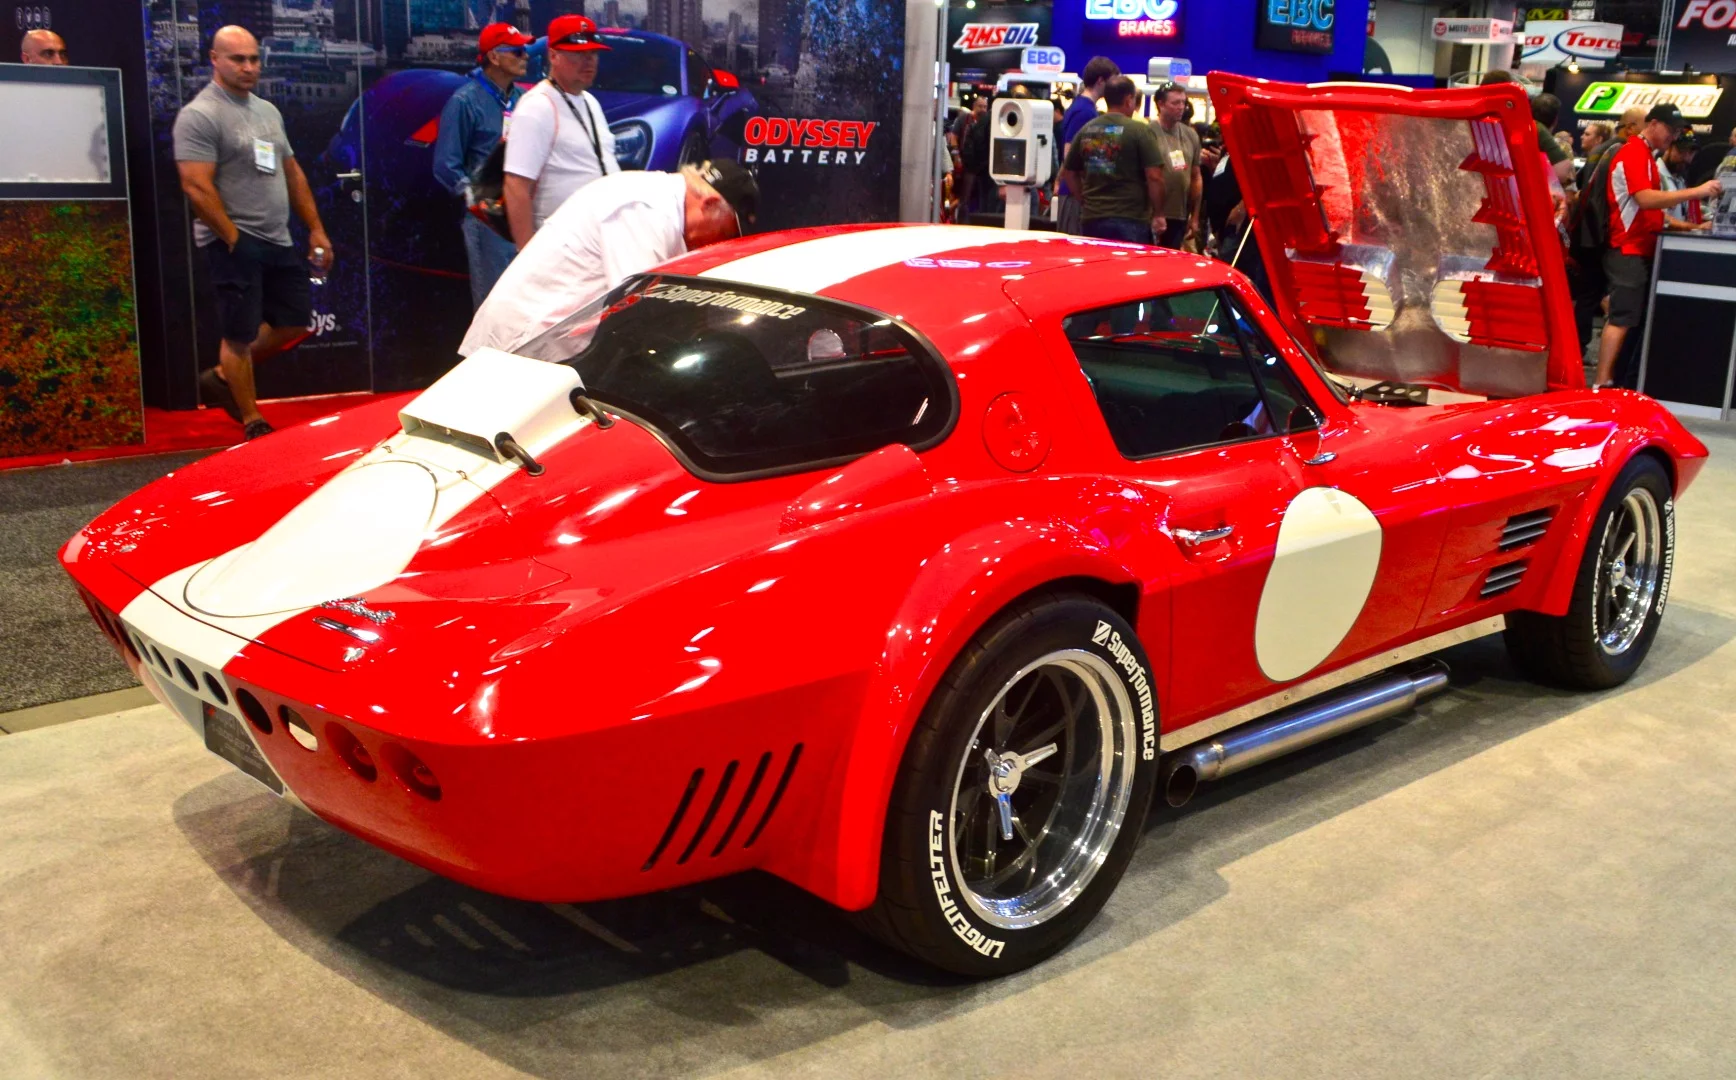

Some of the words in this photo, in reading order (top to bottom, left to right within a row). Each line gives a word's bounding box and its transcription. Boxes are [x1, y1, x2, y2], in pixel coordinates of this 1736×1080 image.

[1118, 20, 1174, 36] BRAKES
[1677, 0, 1736, 29] FO
[956, 24, 1038, 52] AMSOIL
[1027, 50, 1061, 65] EBC
[744, 116, 876, 149] ODYSSEY
[745, 148, 866, 165] BATTERY
[663, 284, 806, 320] Superformance
[1655, 512, 1675, 616] Superformance
[1107, 631, 1155, 761] Superformance
